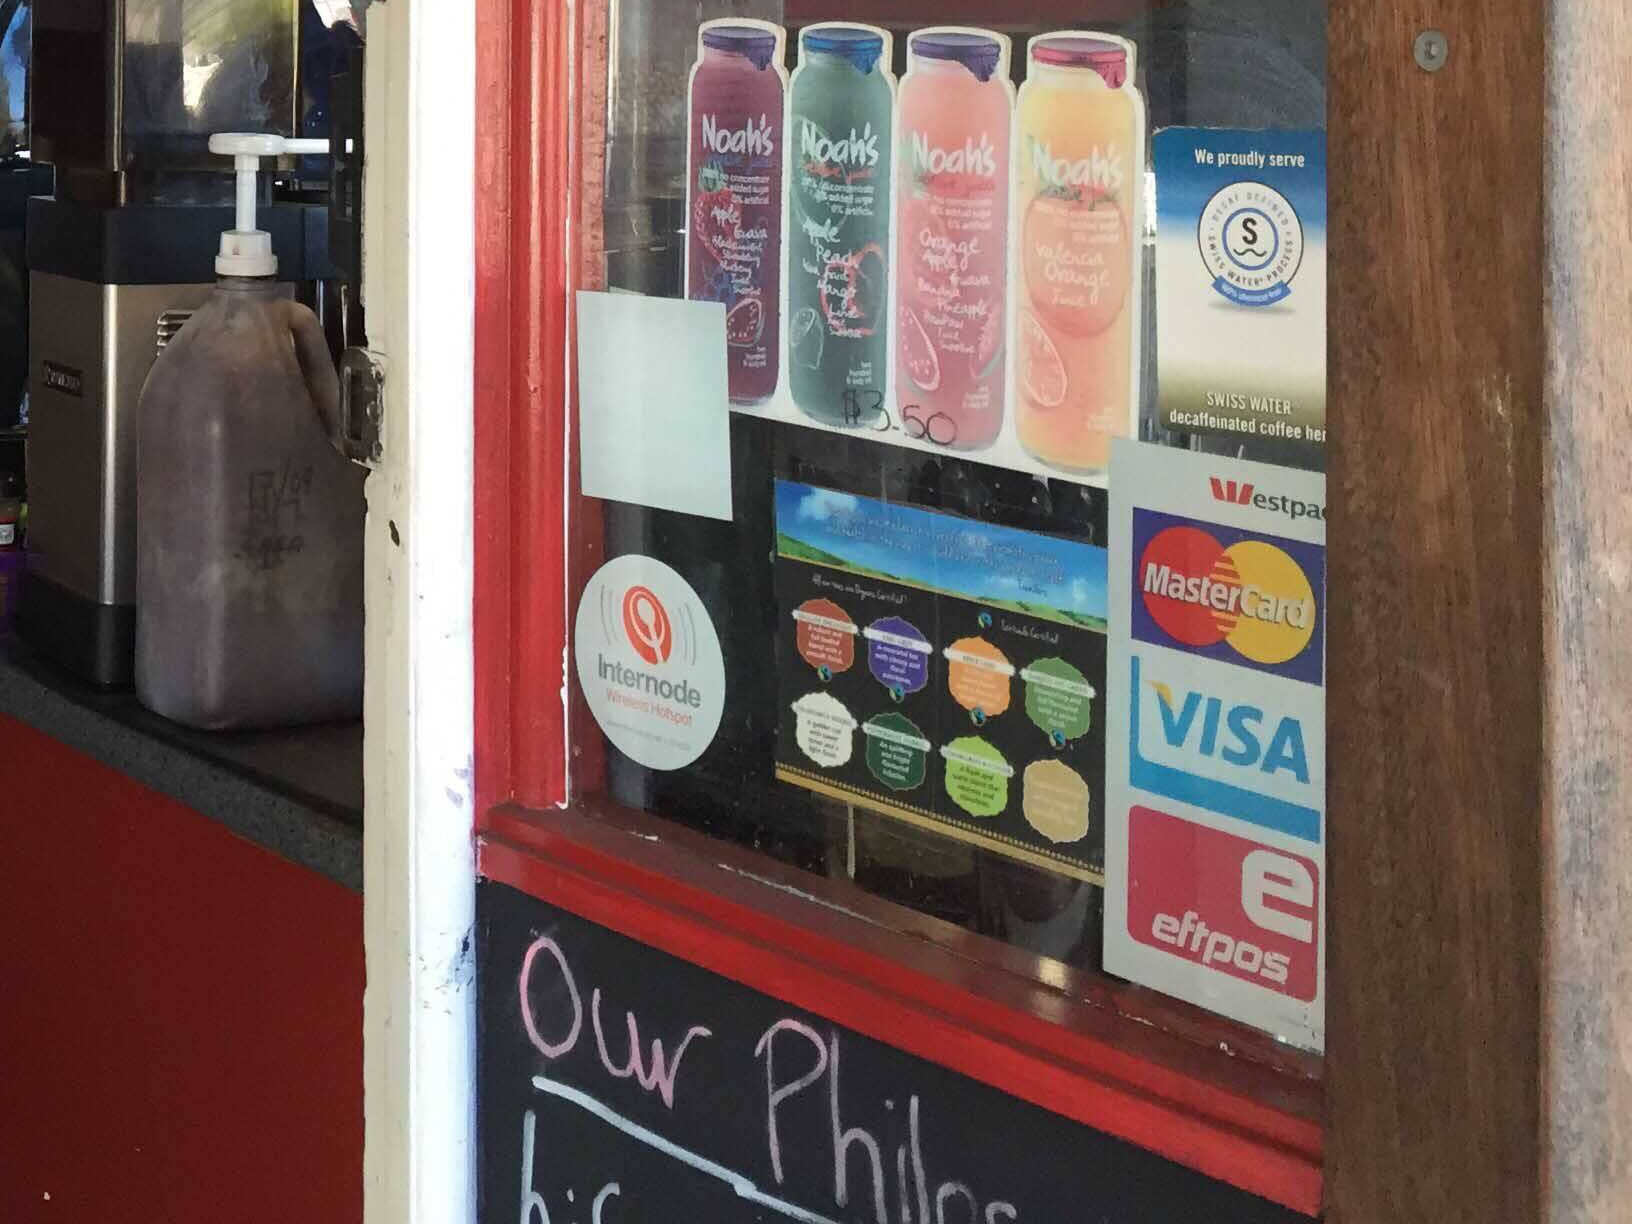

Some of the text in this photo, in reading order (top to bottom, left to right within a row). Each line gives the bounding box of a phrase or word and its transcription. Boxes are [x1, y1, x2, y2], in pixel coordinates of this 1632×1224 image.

[702, 113, 774, 156] Noah's
[801, 120, 879, 168] Noah's
[911, 130, 996, 176] Noah's
[1194, 148, 1305, 168] We proudly serve
[1029, 134, 1122, 187] Noah's
[1242, 217, 1258, 245] S
[842, 389, 957, 446] $3.50
[1169, 409, 1327, 442] decaffeinated coffee her
[1207, 391, 1291, 415] SWISS WATER
[1143, 561, 1311, 629] MasterCard
[598, 653, 701, 708] Internode
[606, 687, 693, 727] Wireless Hotspot
[1146, 679, 1310, 784] VISA
[1151, 909, 1290, 985] eftpos
[520, 935, 713, 1110] Our
